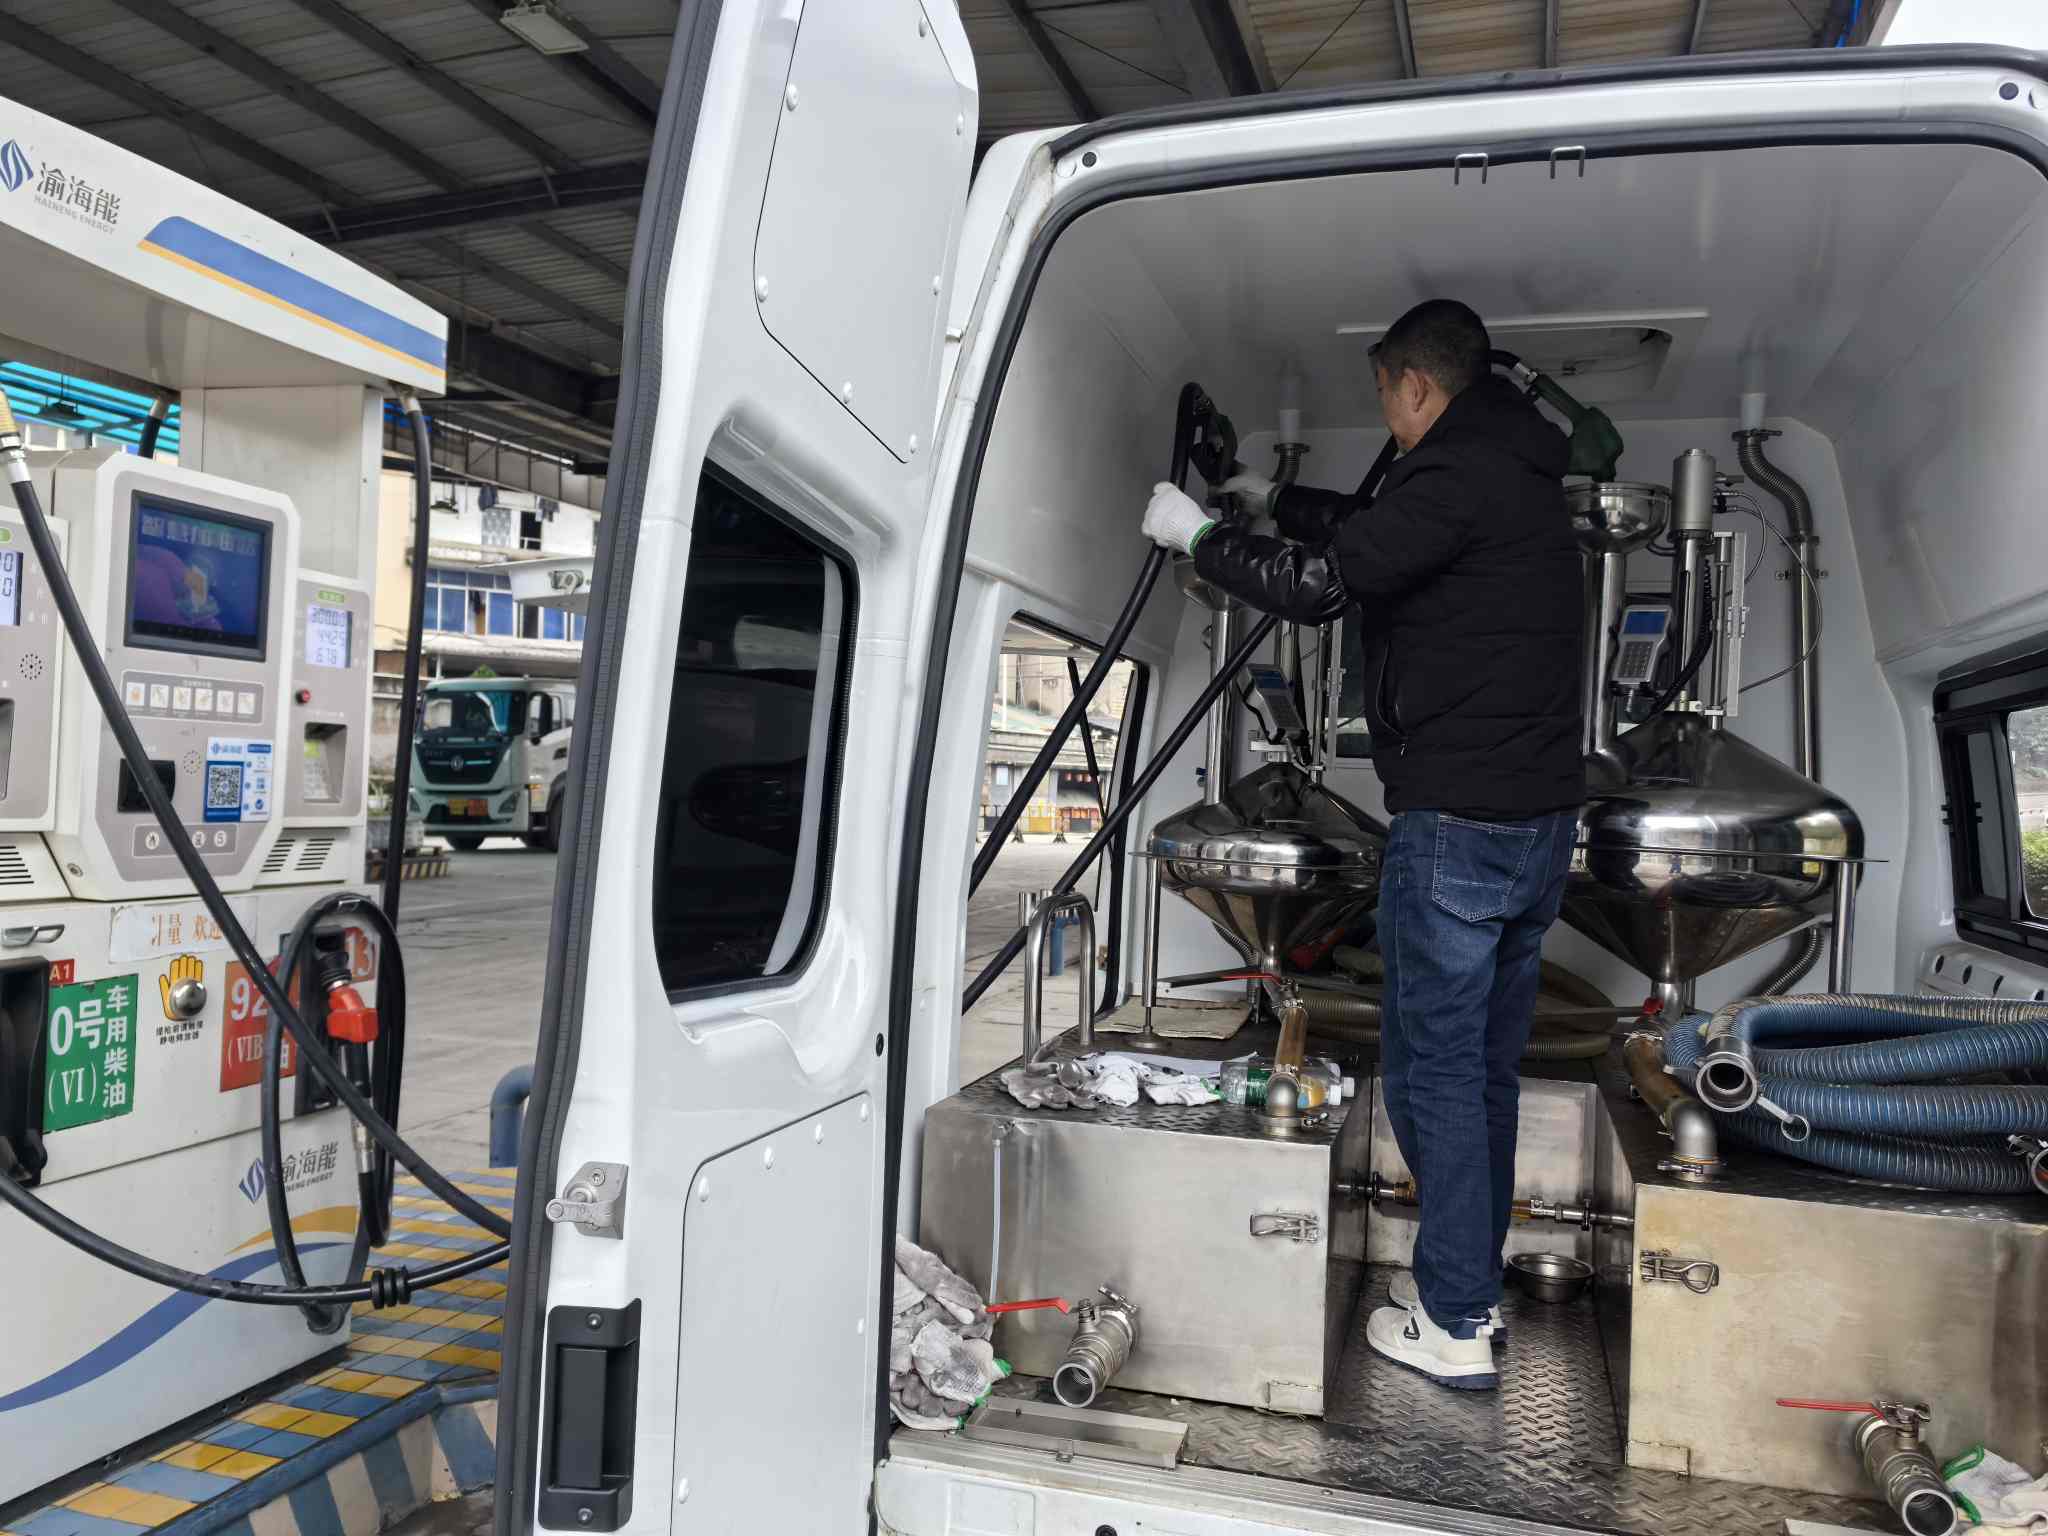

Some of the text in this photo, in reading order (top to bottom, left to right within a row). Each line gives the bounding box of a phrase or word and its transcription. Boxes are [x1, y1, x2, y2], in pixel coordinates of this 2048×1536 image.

[37, 161, 121, 225] 渝海能
[49, 963, 72, 982] A1
[50, 998, 105, 1057] 0号
[102, 984, 130, 1108] 车用柴油
[48, 1061, 98, 1114] (VI)
